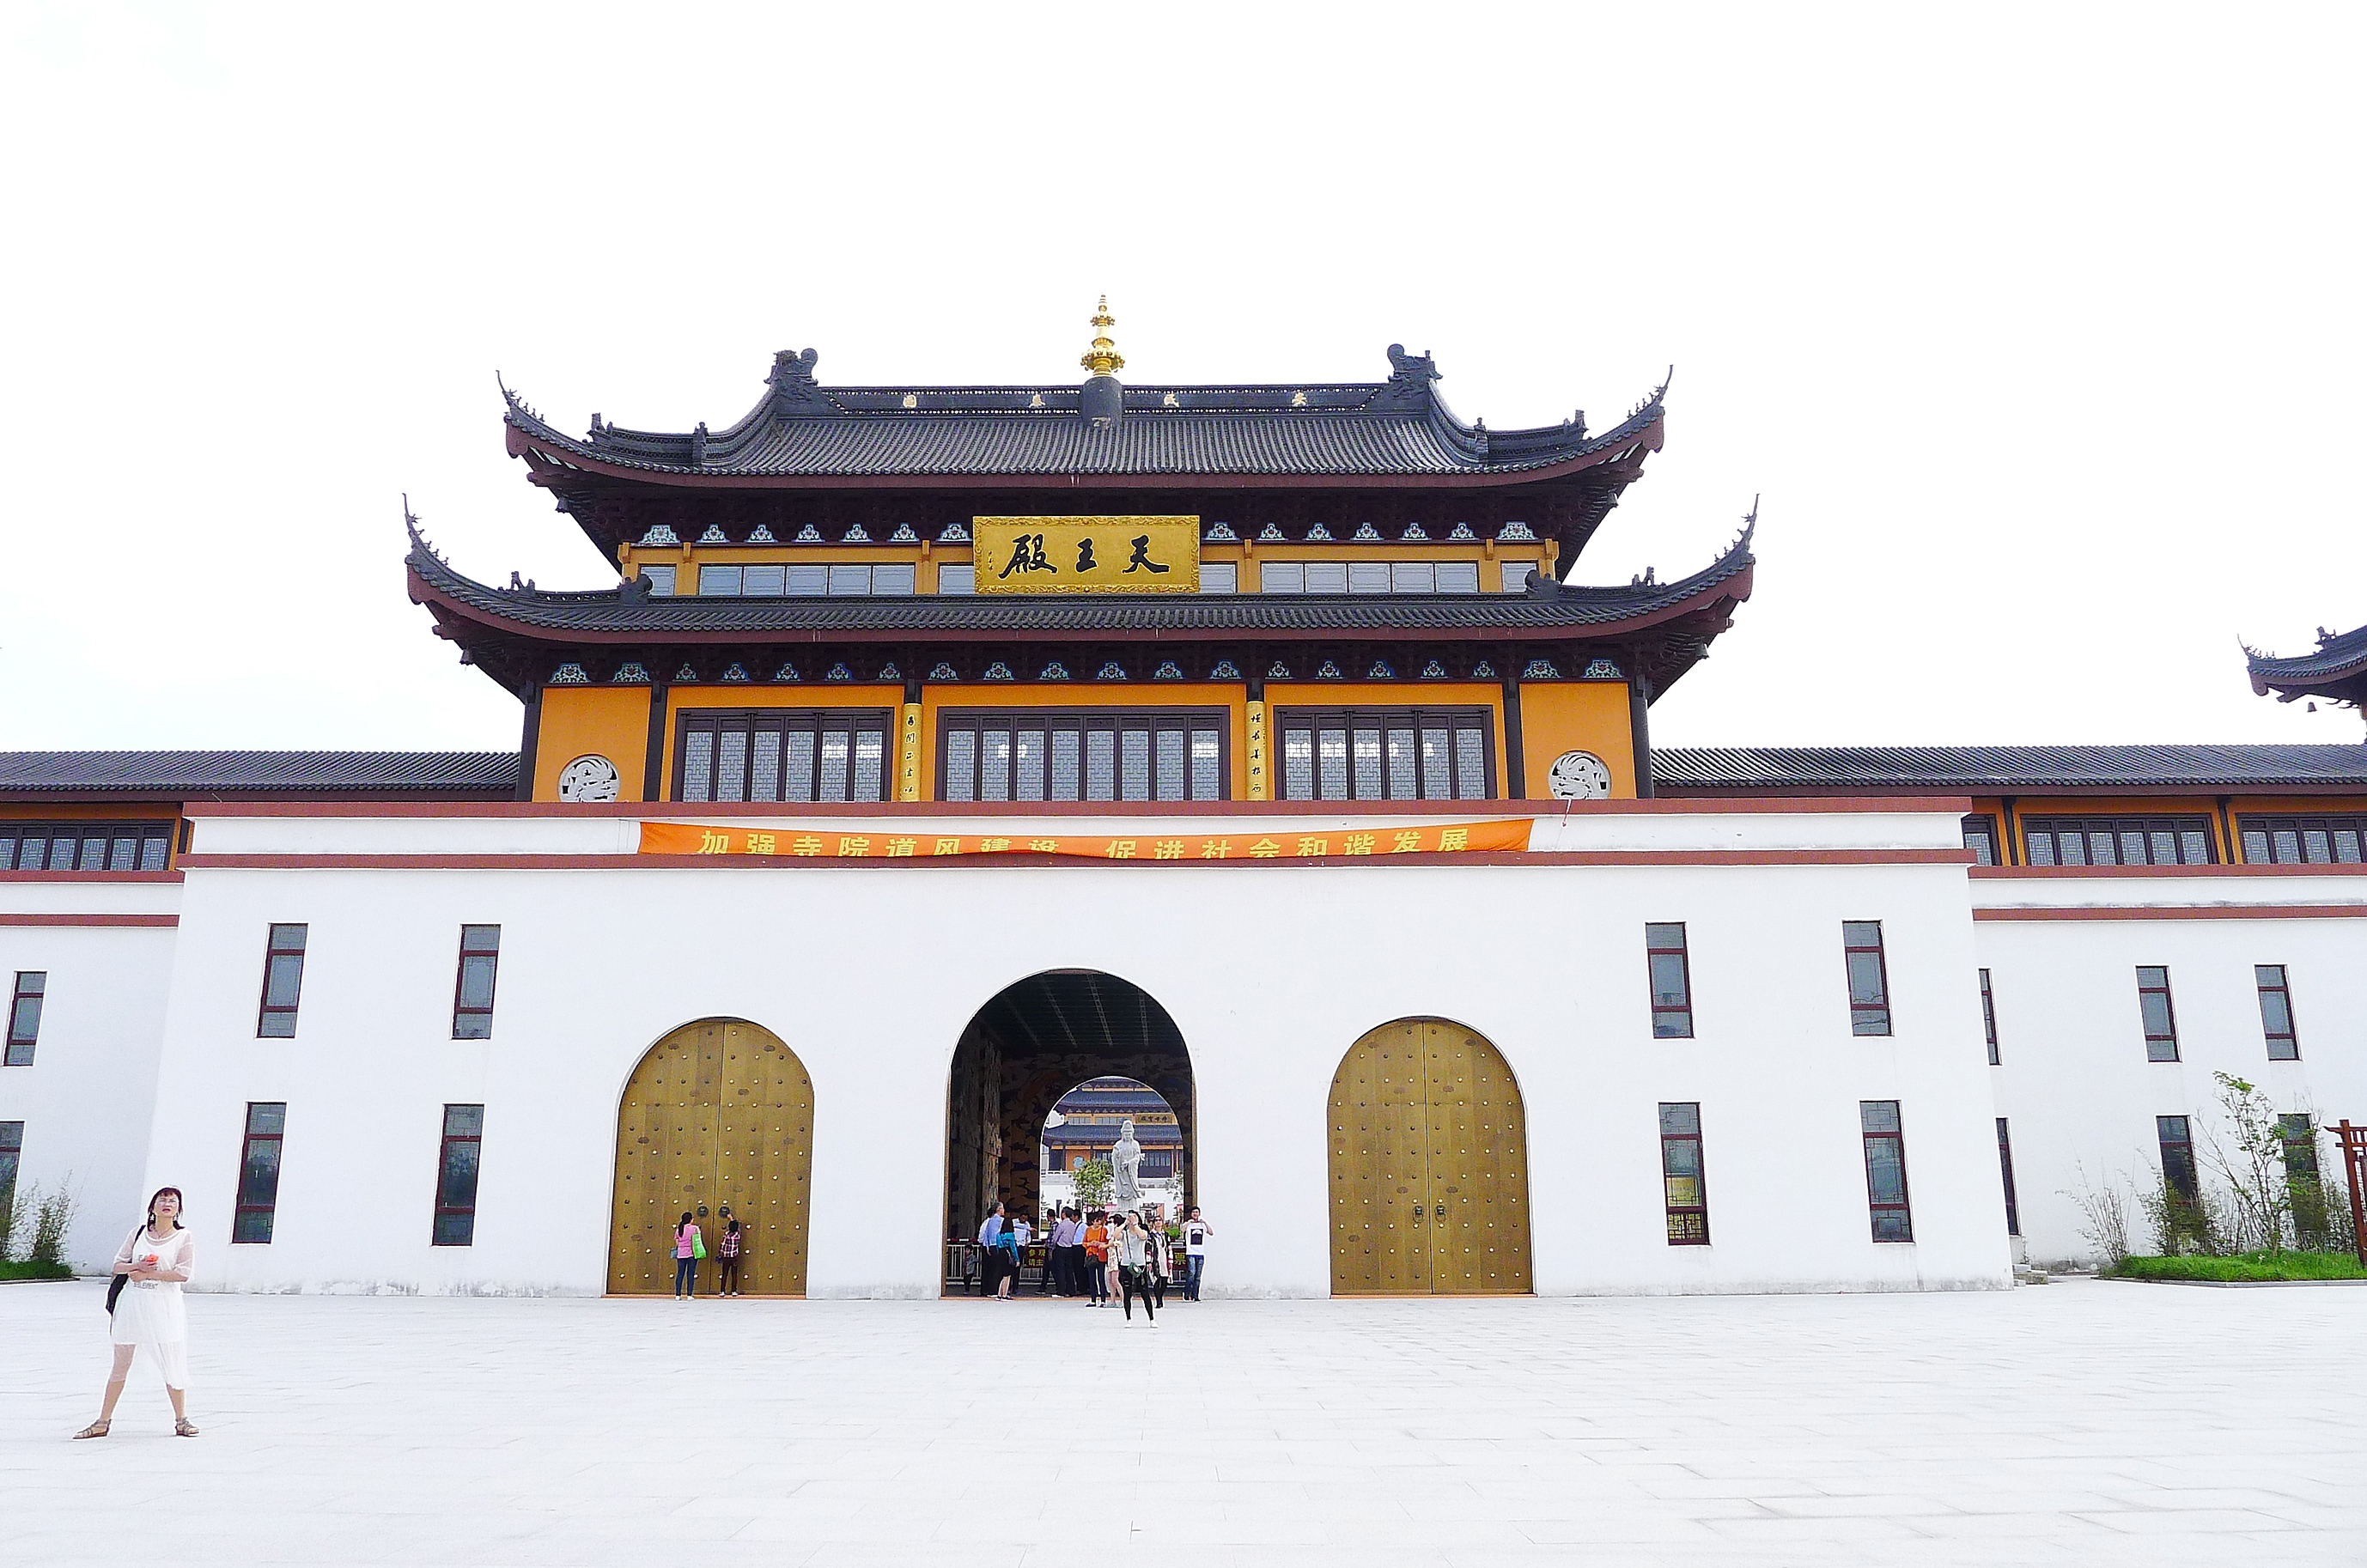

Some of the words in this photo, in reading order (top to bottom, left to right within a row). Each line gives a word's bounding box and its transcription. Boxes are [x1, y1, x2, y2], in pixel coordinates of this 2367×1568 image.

[997, 533, 1171, 580] 天王殿
[697, 830, 1060, 857] 加强寺院道风建设
[1105, 829, 1469, 860] 促进社会和谐发展
